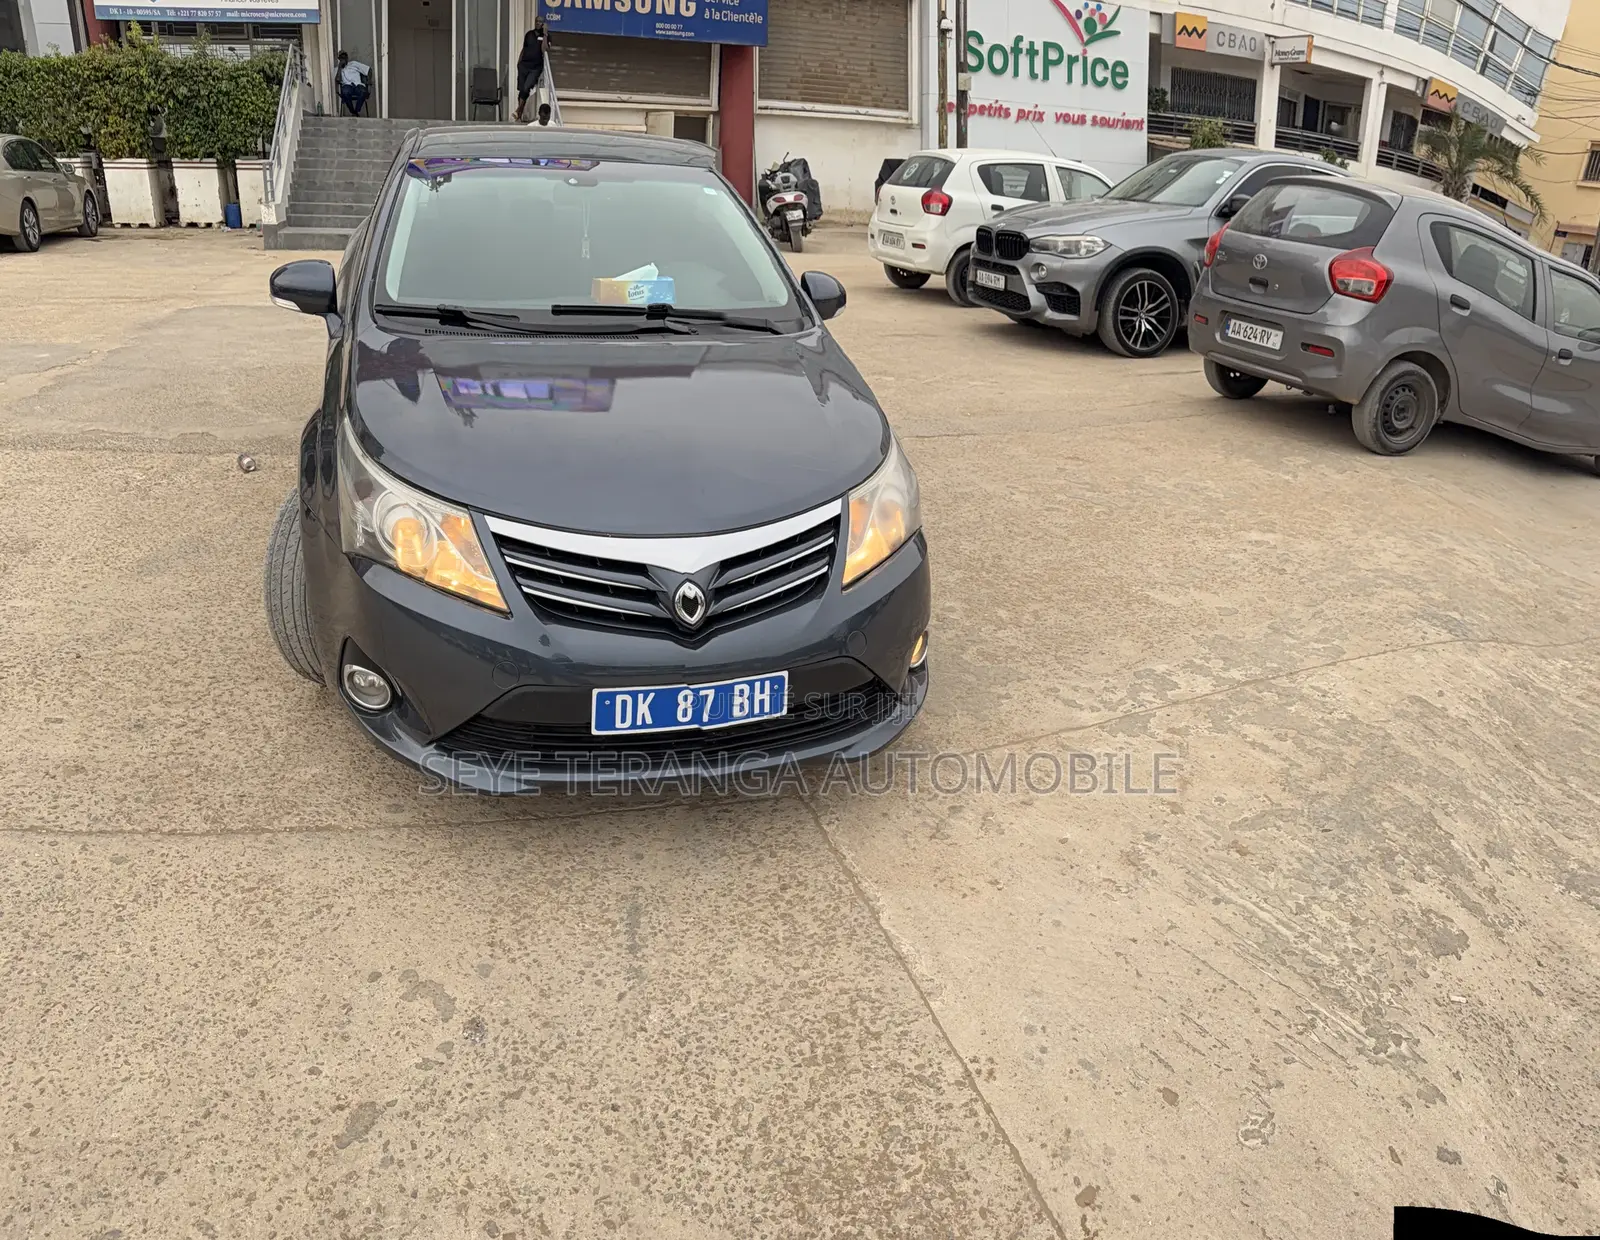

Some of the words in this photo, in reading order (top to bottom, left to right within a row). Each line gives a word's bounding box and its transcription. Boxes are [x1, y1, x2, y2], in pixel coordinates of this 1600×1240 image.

[704, 8, 710, 19] à
[711, 9, 720, 20] la
[721, 10, 763, 24] Clientèle
[1216, 31, 1257, 52] CBAO
[967, 30, 1129, 90] SoftPrice
[967, 99, 1011, 119] petits
[1015, 104, 1045, 124] prix
[1054, 110, 1087, 126] vous
[1091, 112, 1145, 131] sourient
[1230, 322, 1242, 337] AA
[1243, 325, 1258, 342] 624
[1258, 329, 1273, 345] RY
[615, 692, 655, 729] DK
[677, 689, 715, 723] 87
[732, 680, 771, 718] BH
